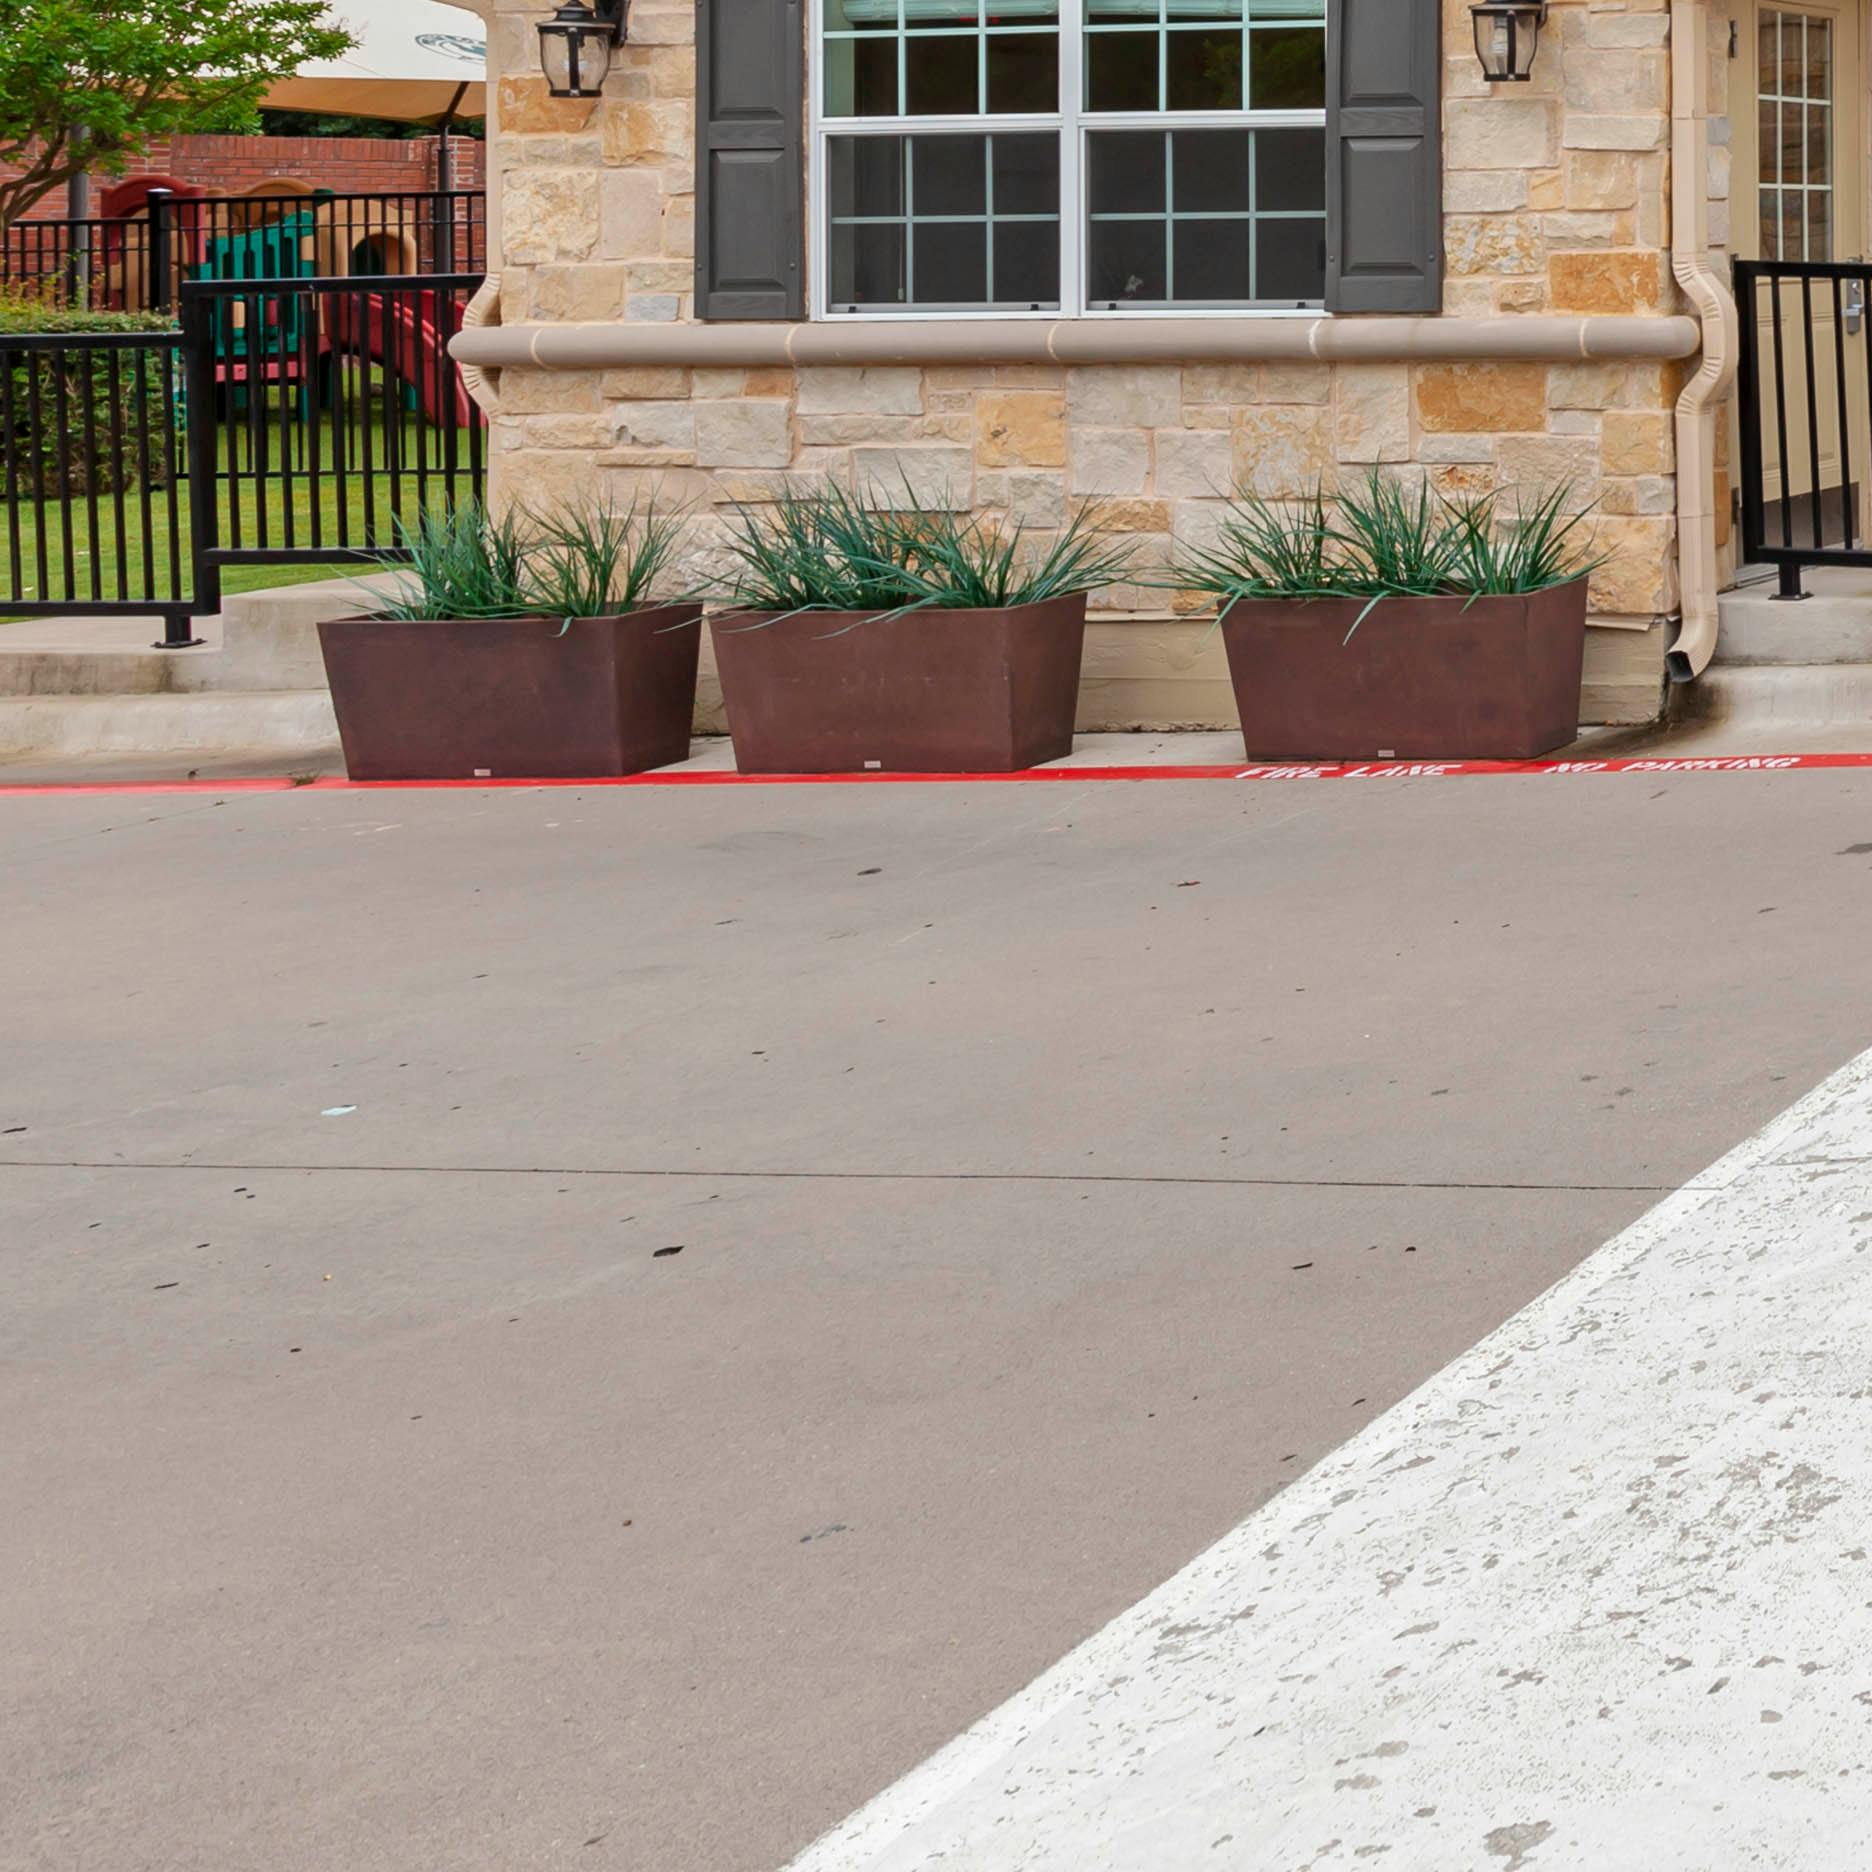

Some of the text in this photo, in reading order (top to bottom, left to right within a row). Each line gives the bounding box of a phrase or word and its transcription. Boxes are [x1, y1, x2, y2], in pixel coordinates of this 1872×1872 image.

[1235, 756, 1801, 779] FIRE LANE NO PARKING
